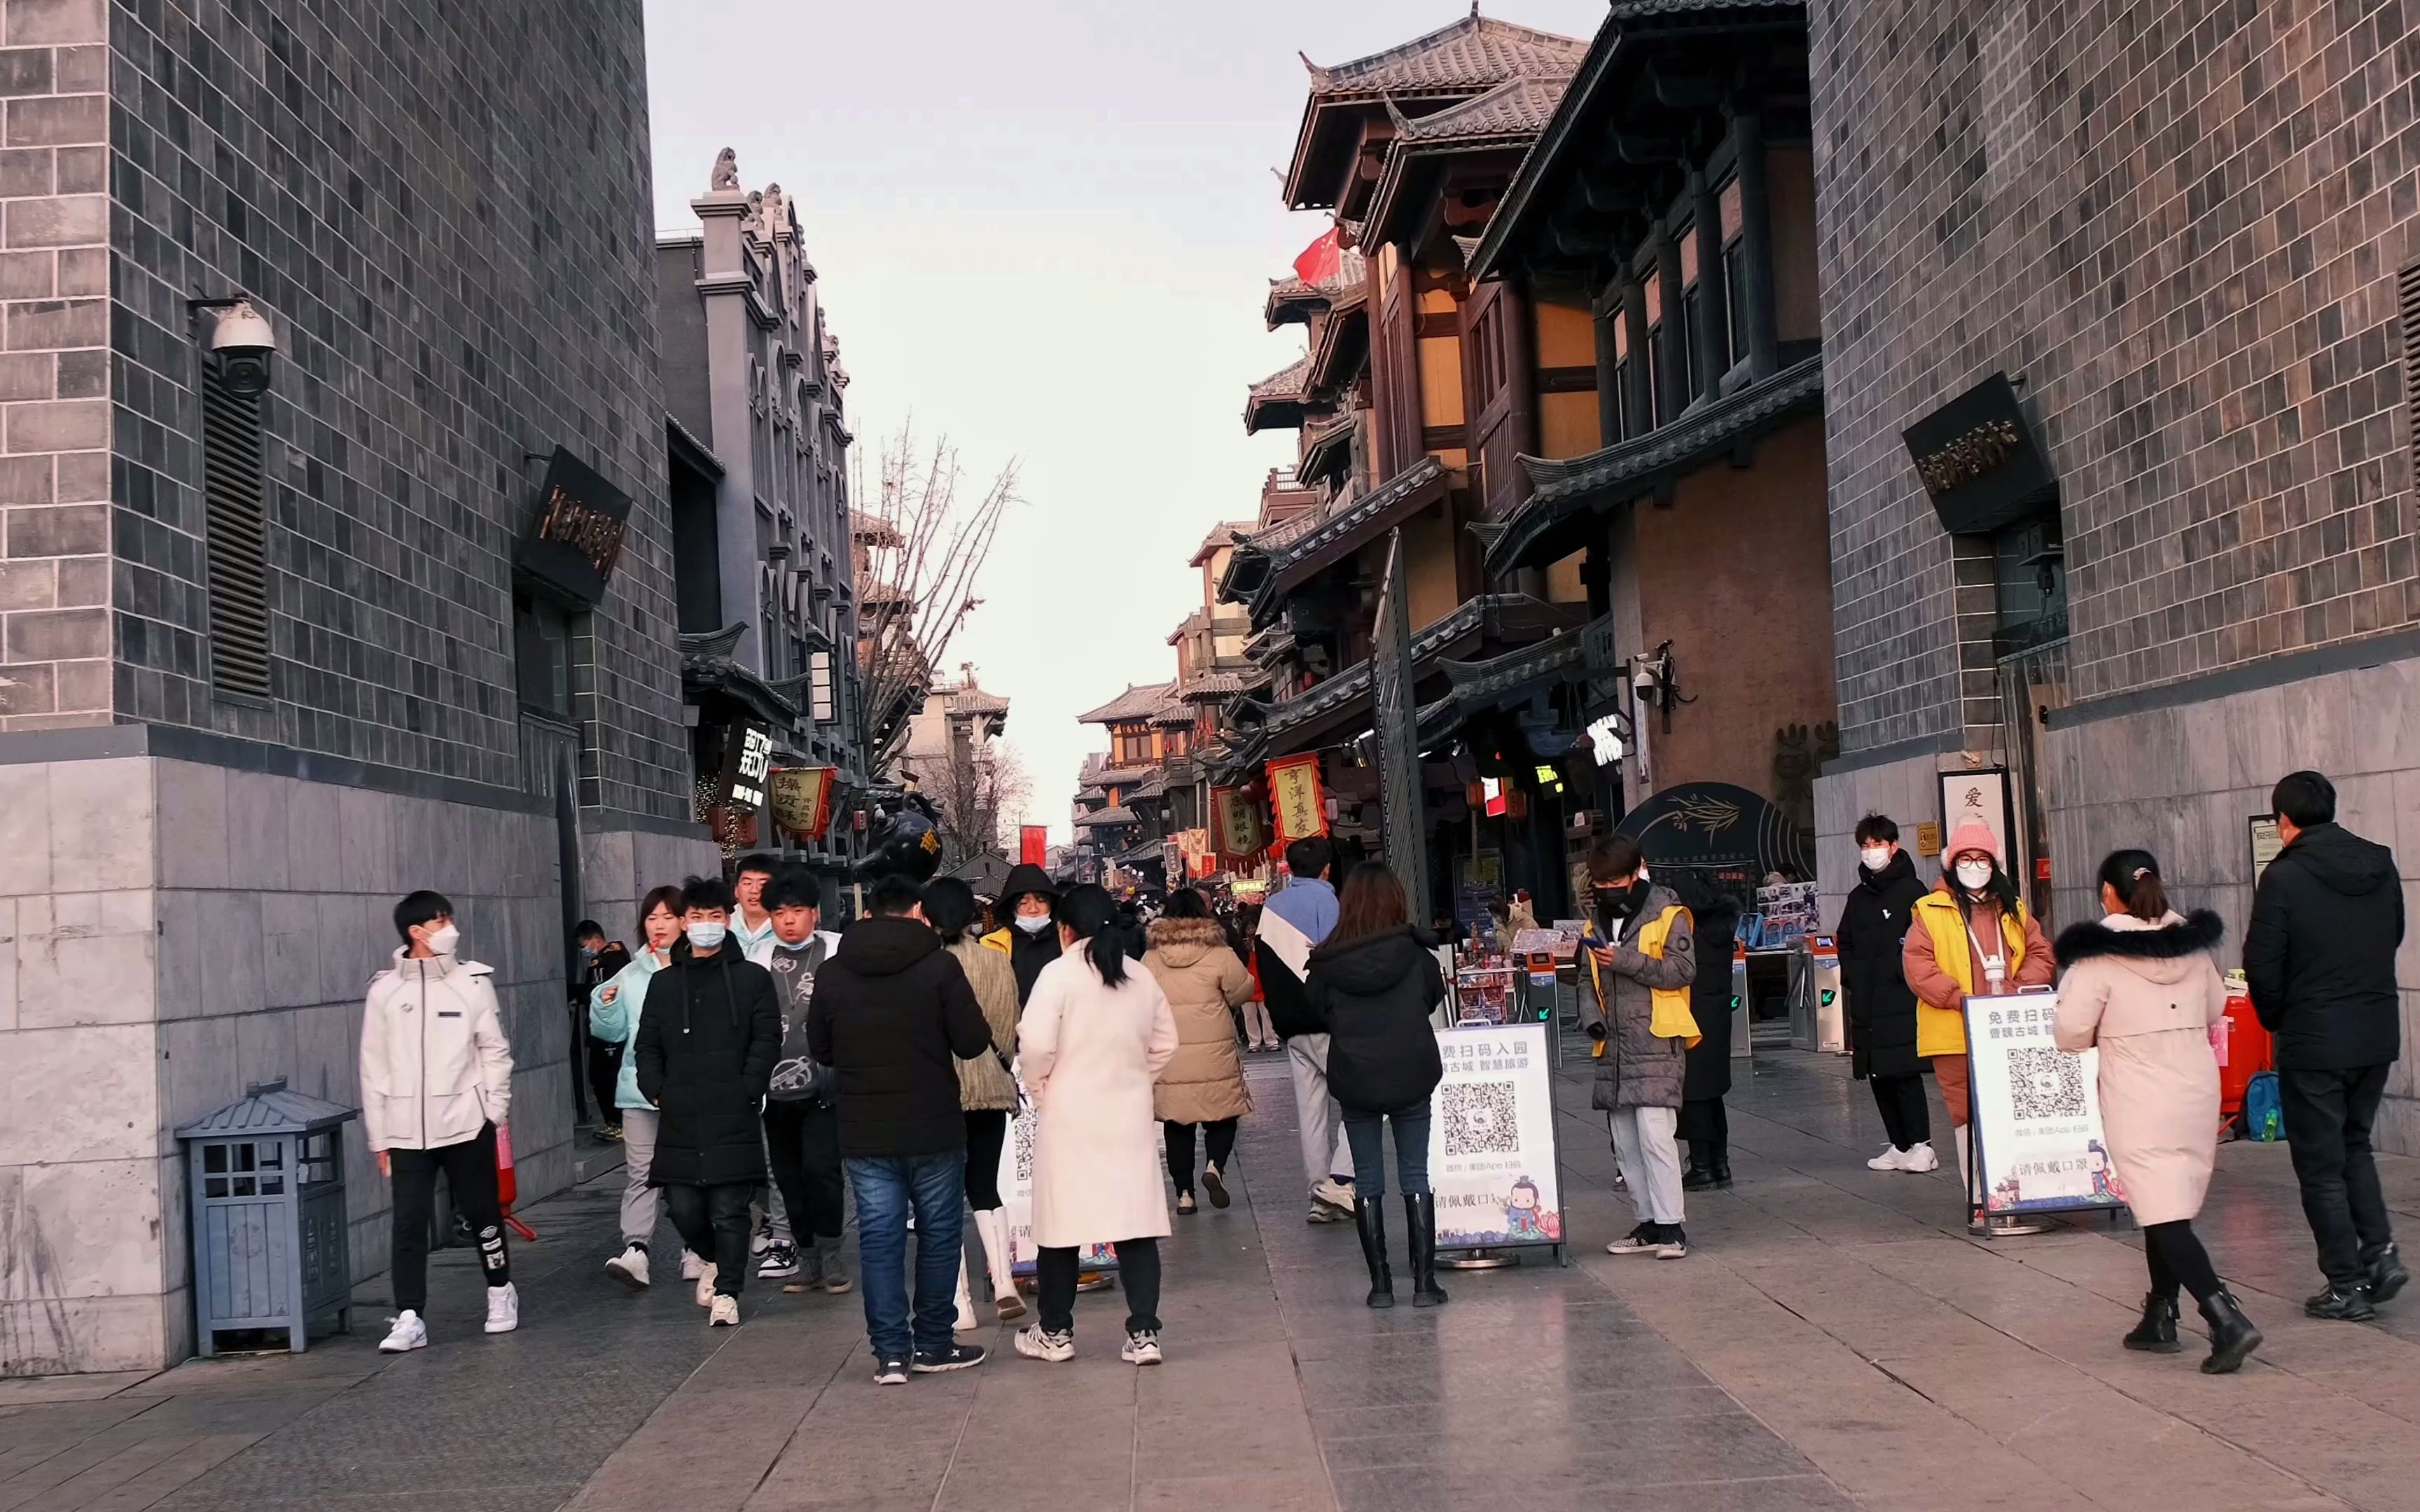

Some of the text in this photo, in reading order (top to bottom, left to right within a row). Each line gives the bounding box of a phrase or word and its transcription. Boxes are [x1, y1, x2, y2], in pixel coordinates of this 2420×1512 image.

[776, 769, 802, 820] 操贡酥
[1989, 1008, 2054, 1025] 免费扫码
[1989, 1025, 2039, 1040] 曹魏古城
[1442, 1041, 1528, 1059] 费扫码入园
[1480, 1057, 1529, 1071] 智慧旅游
[2019, 1158, 2088, 1176] 请佩戴口罩
